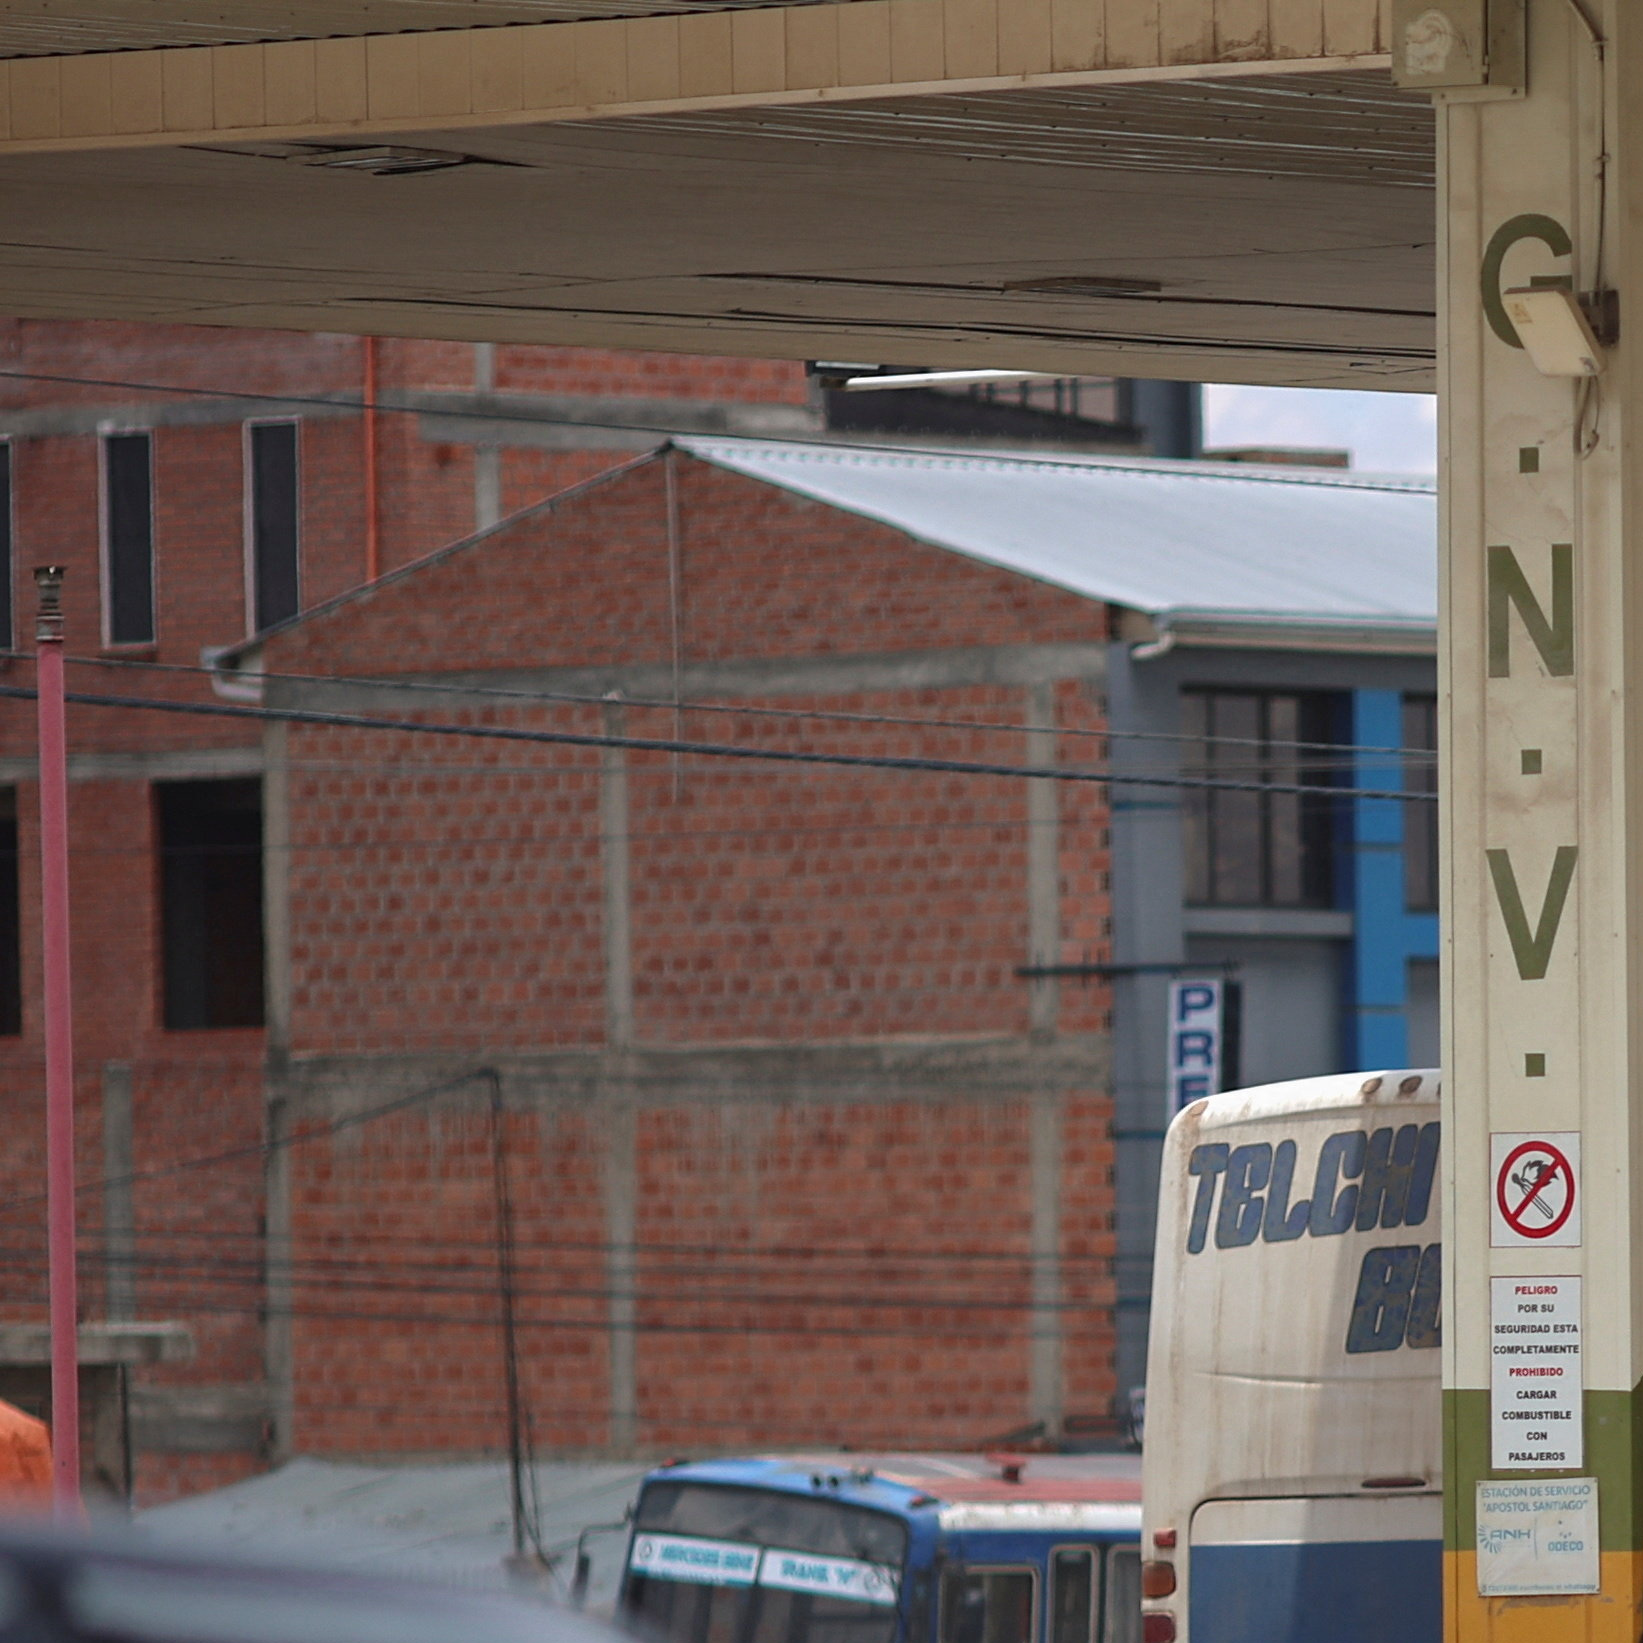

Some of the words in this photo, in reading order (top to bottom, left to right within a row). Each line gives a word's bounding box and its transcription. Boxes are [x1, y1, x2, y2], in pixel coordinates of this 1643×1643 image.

[1514, 1285, 1558, 1295] PELIGRO
[1517, 1304, 1538, 1313] POR
[1540, 1304, 1555, 1313] SU
[1494, 1324, 1551, 1334] SEGURIDAD
[1553, 1324, 1578, 1333] ESTA
[1493, 1344, 1579, 1355] COMPLETAMENTE
[1508, 1367, 1564, 1377] PROHIBIDO
[1516, 1390, 1557, 1399] CARGAR
[1501, 1410, 1572, 1420] COMBUSTIBLE
[1526, 1431, 1547, 1441] CON
[1508, 1451, 1566, 1461] PASAJEROS
[1529, 1487, 1542, 1497] DE
[1544, 1485, 1591, 1496] SERVICIO
[1547, 1541, 1584, 1552] ODECO
